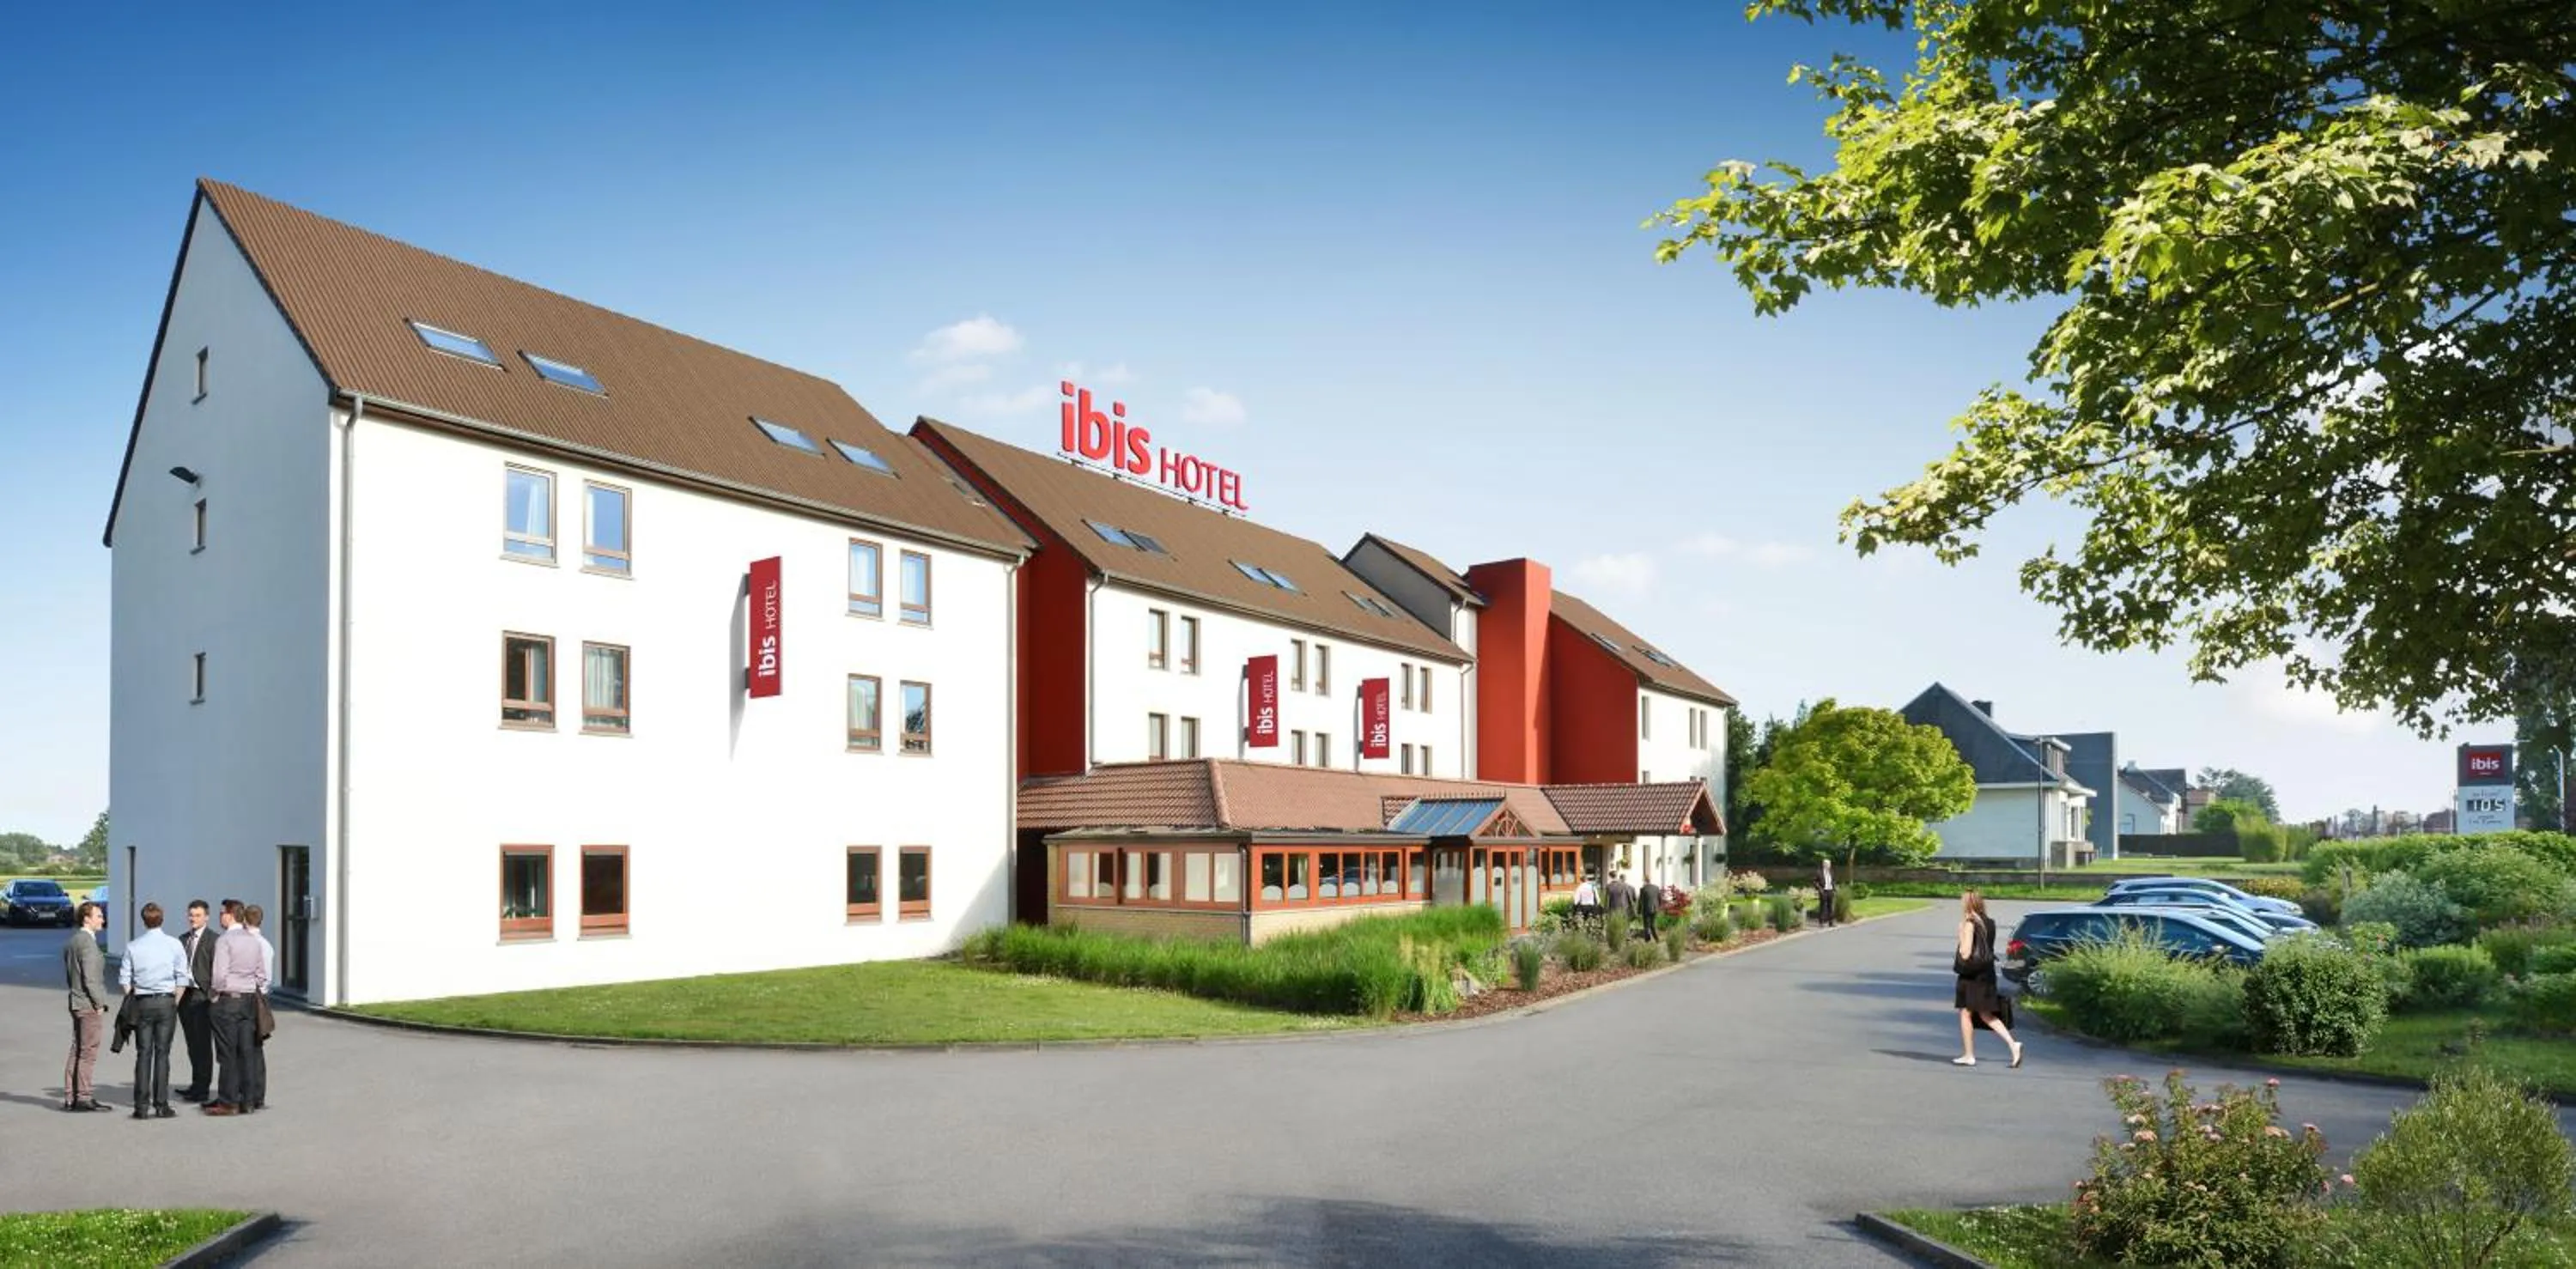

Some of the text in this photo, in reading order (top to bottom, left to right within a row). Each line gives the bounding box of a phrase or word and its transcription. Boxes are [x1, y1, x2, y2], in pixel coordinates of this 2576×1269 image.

[1061, 380, 1249, 510] ibis HOTEL
[758, 580, 777, 677] ibis HOTEL
[1256, 671, 1274, 734] ibis HOTEL
[1370, 692, 1388, 747] ibis HOTEL
[2471, 757, 2500, 769] ibis
